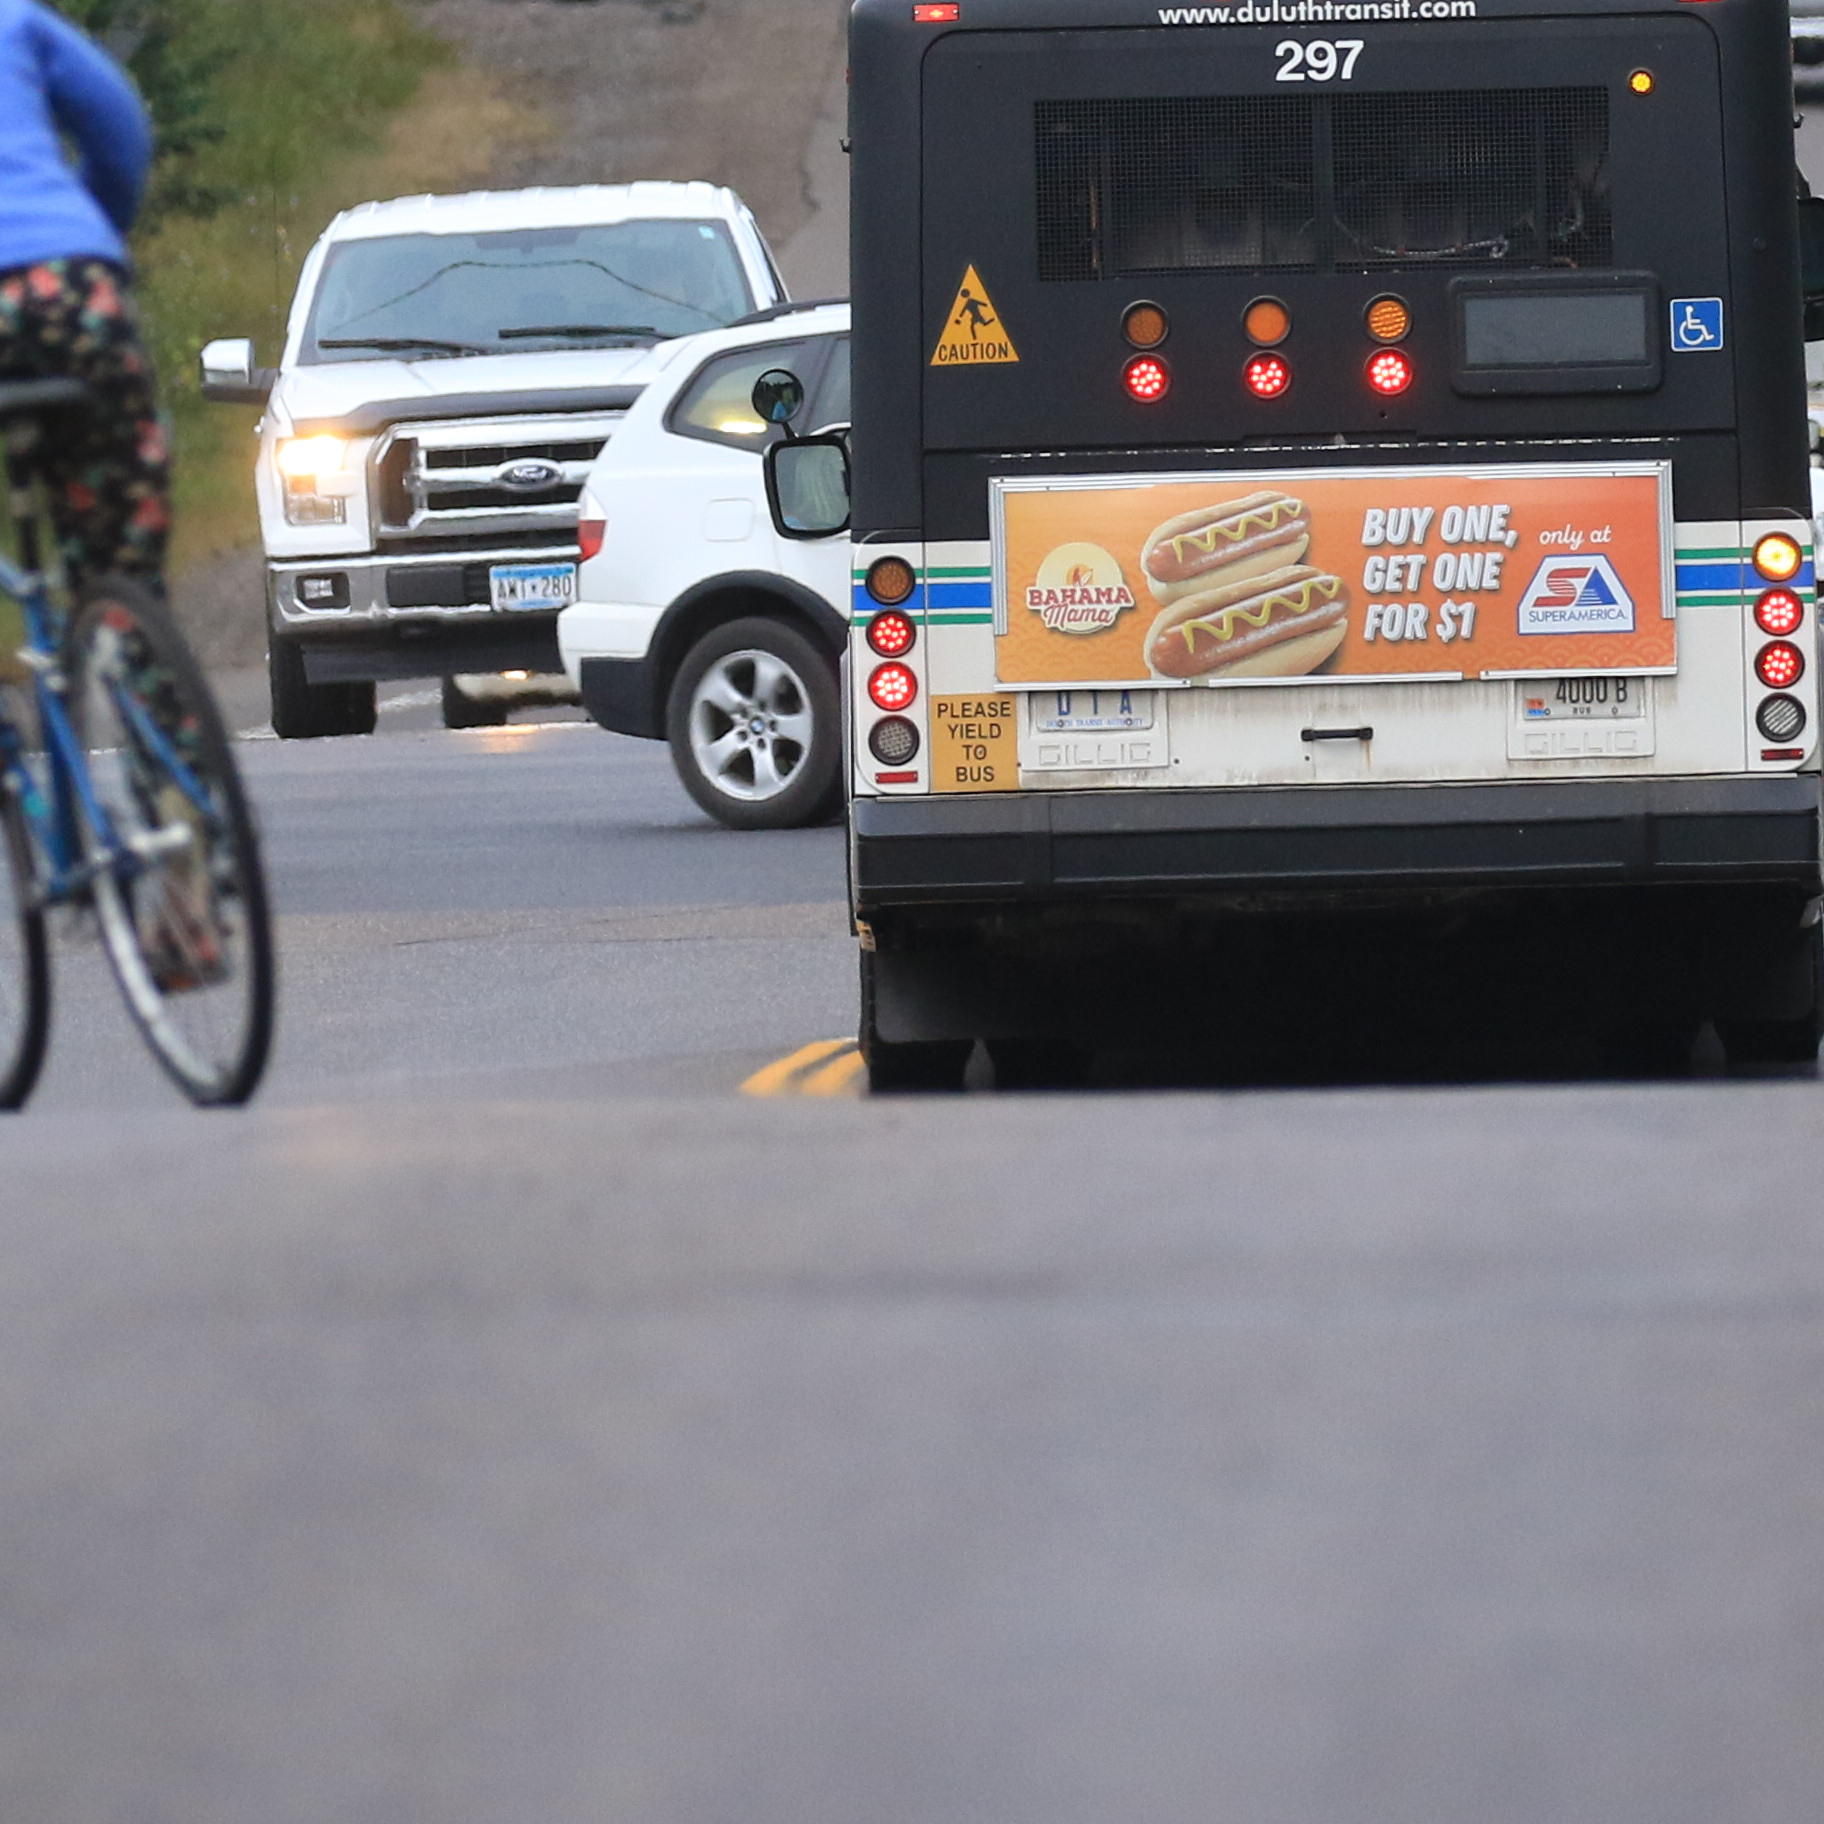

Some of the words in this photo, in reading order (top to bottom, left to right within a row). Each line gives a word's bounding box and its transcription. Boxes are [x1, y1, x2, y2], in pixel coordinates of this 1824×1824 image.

[1275, 39, 1365, 82] 297
[938, 342, 1009, 362] CAUTION
[1361, 507, 1434, 546] BUY
[1440, 504, 1518, 548] ONE,
[1539, 524, 1584, 550] only
[1590, 525, 1612, 543] at
[1362, 554, 1426, 594] GET
[1432, 552, 1503, 592] ONE
[541, 575, 572, 597] 280
[1028, 587, 1132, 607] BAHAMA
[1043, 601, 1113, 629] Mama
[1363, 602, 1428, 642] FOR
[1436, 598, 1476, 644] $1
[1528, 608, 1628, 623] SUPERAMERICA
[937, 701, 1011, 719] PLEASE
[947, 723, 1002, 740] YIELD
[962, 745, 987, 761] TO
[956, 766, 995, 783] BUS
